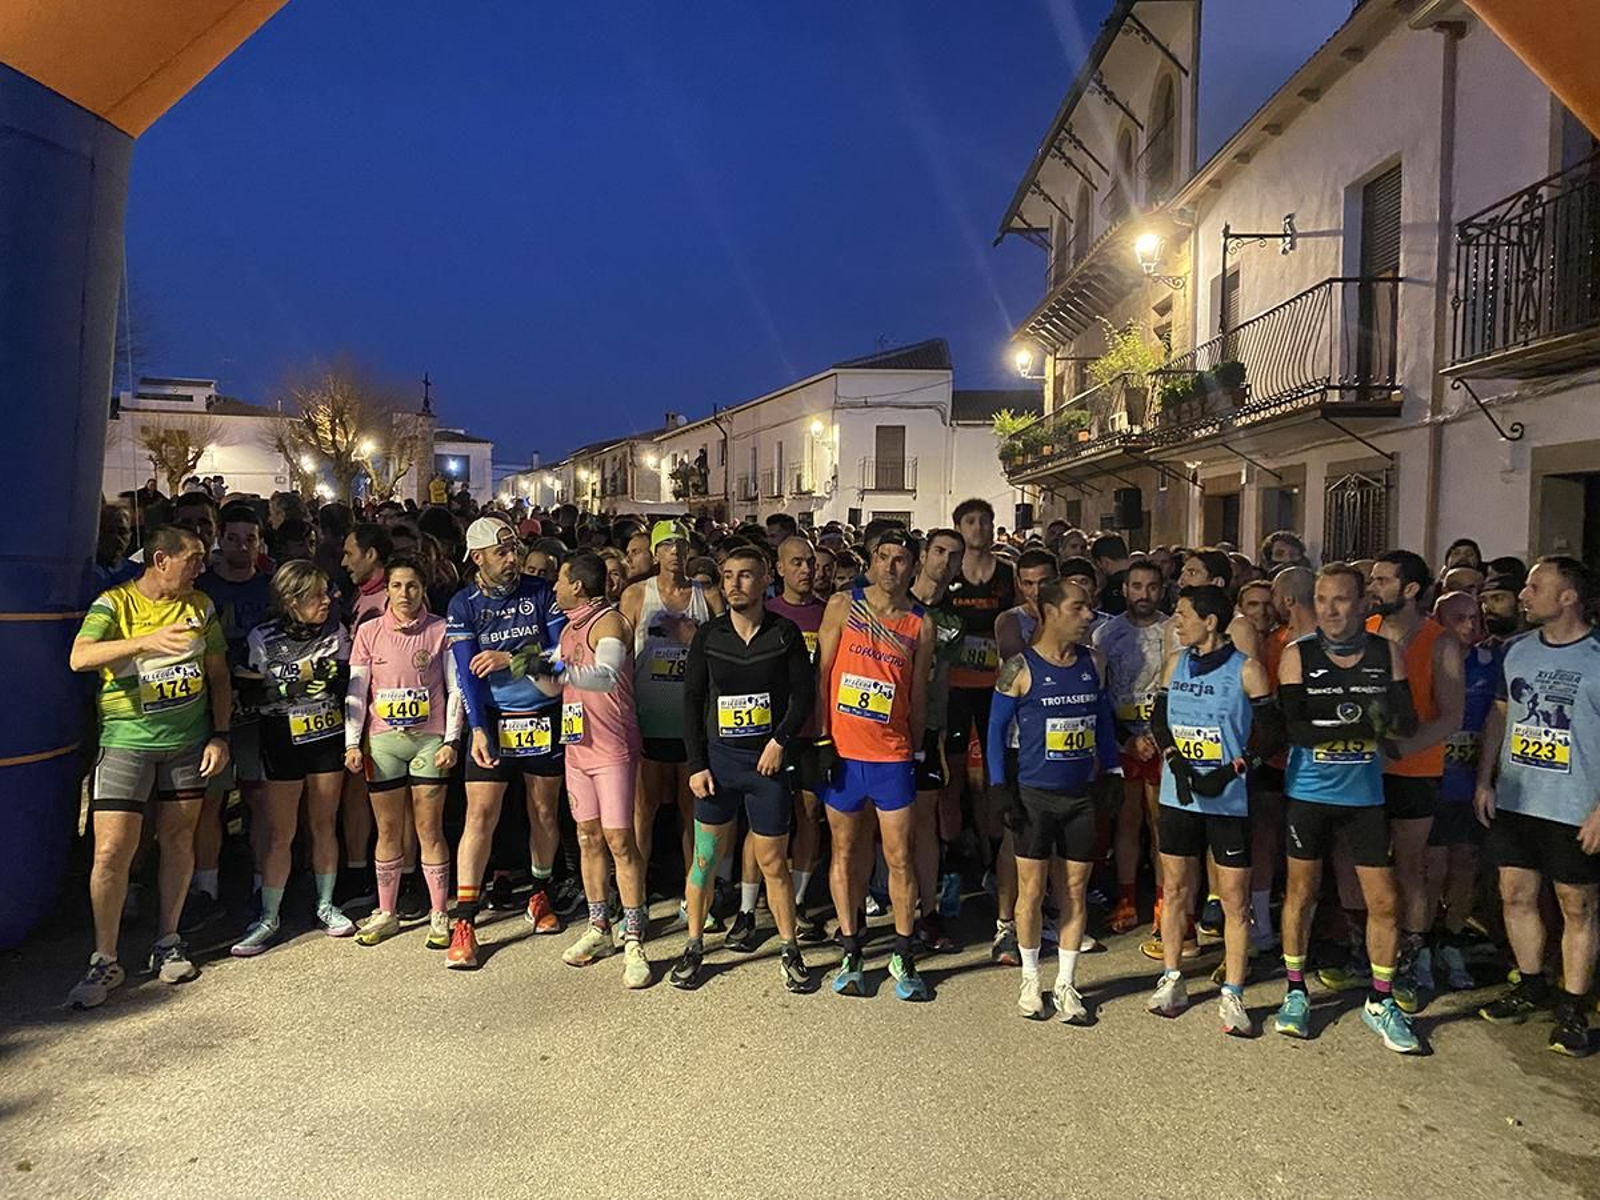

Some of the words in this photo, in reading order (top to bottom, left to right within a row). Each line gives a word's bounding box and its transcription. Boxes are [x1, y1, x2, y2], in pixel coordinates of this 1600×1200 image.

[490, 625, 540, 642] BULEVAR
[667, 660, 686, 674] 78
[156, 679, 191, 700] 174
[1172, 681, 1215, 697] nerja
[858, 692, 870, 708] 8
[387, 702, 420, 717] 140
[733, 709, 755, 726] 51
[303, 712, 335, 732] 166
[515, 731, 535, 747] 14
[1064, 732, 1086, 749] 40
[1182, 741, 1204, 759] 46
[1520, 739, 1556, 760] 223
